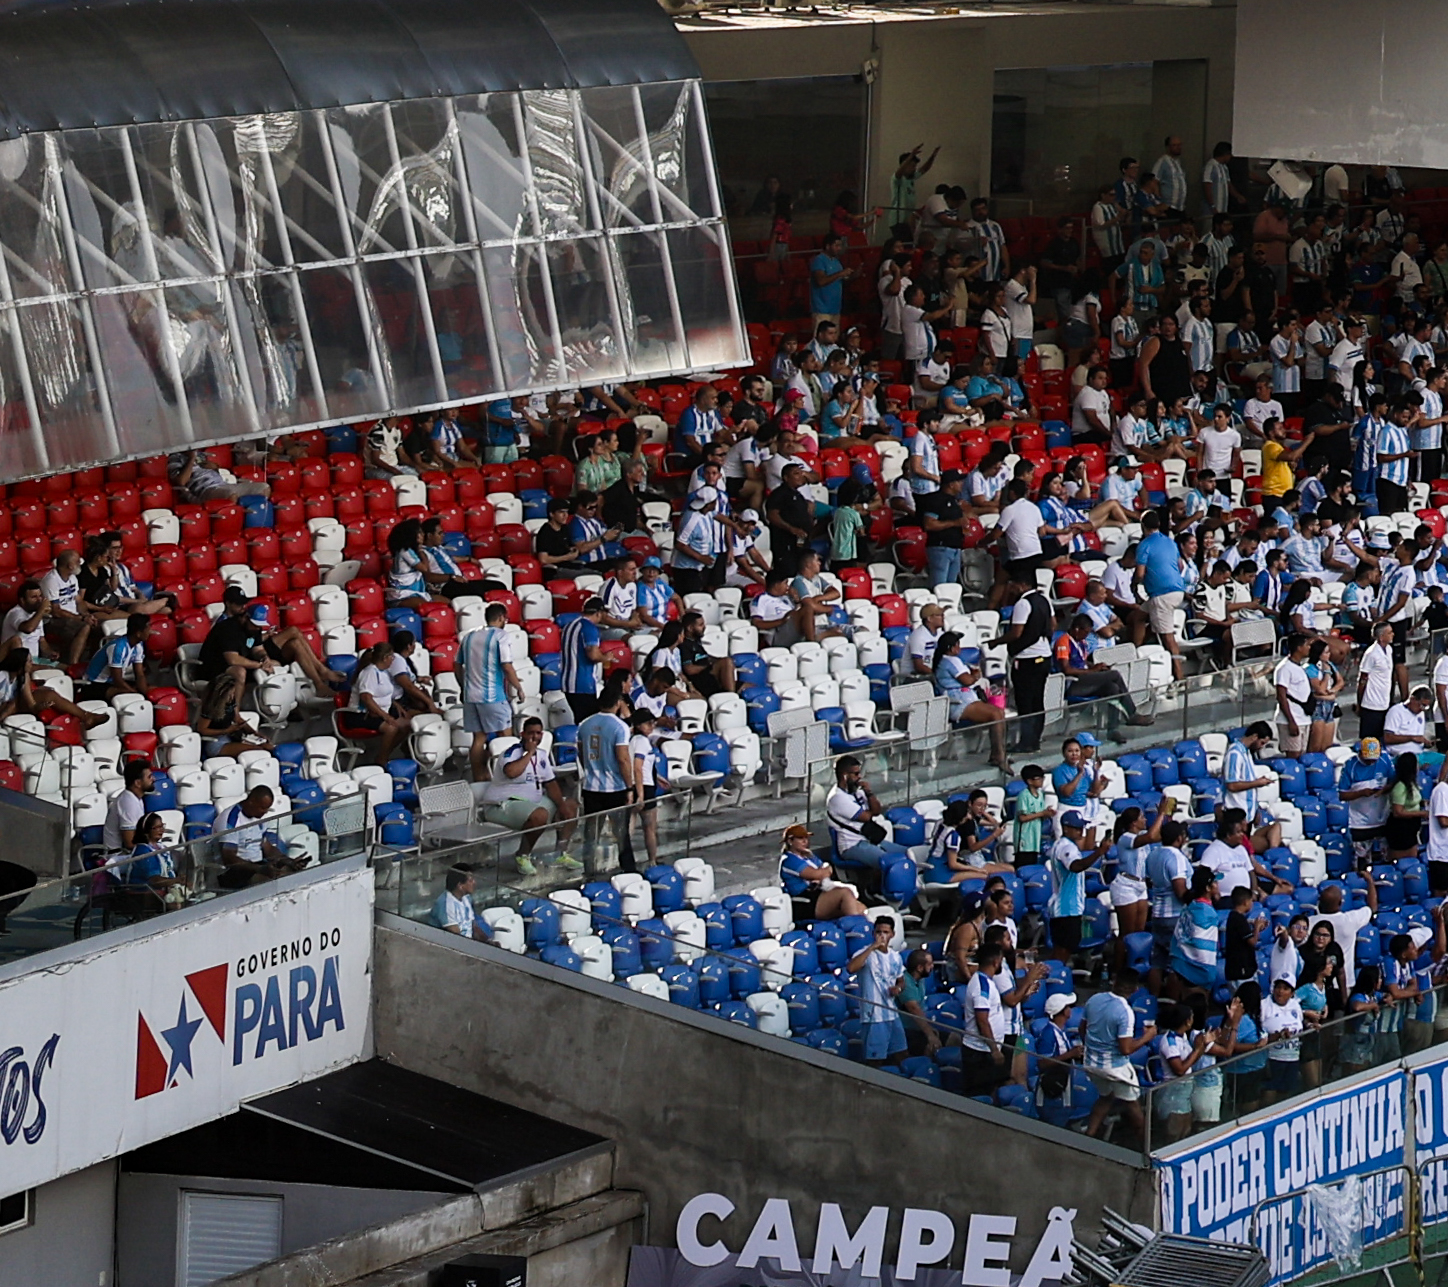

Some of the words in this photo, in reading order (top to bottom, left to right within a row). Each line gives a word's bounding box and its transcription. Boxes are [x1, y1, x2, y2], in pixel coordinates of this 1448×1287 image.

[236, 937, 312, 978] GOVERNO
[320, 927, 342, 952] DO
[233, 954, 346, 1067] PARÁ
[1415, 1072, 1434, 1145] O
[1180, 1130, 1268, 1236] PODER
[1273, 1078, 1405, 1196] CONTINUA
